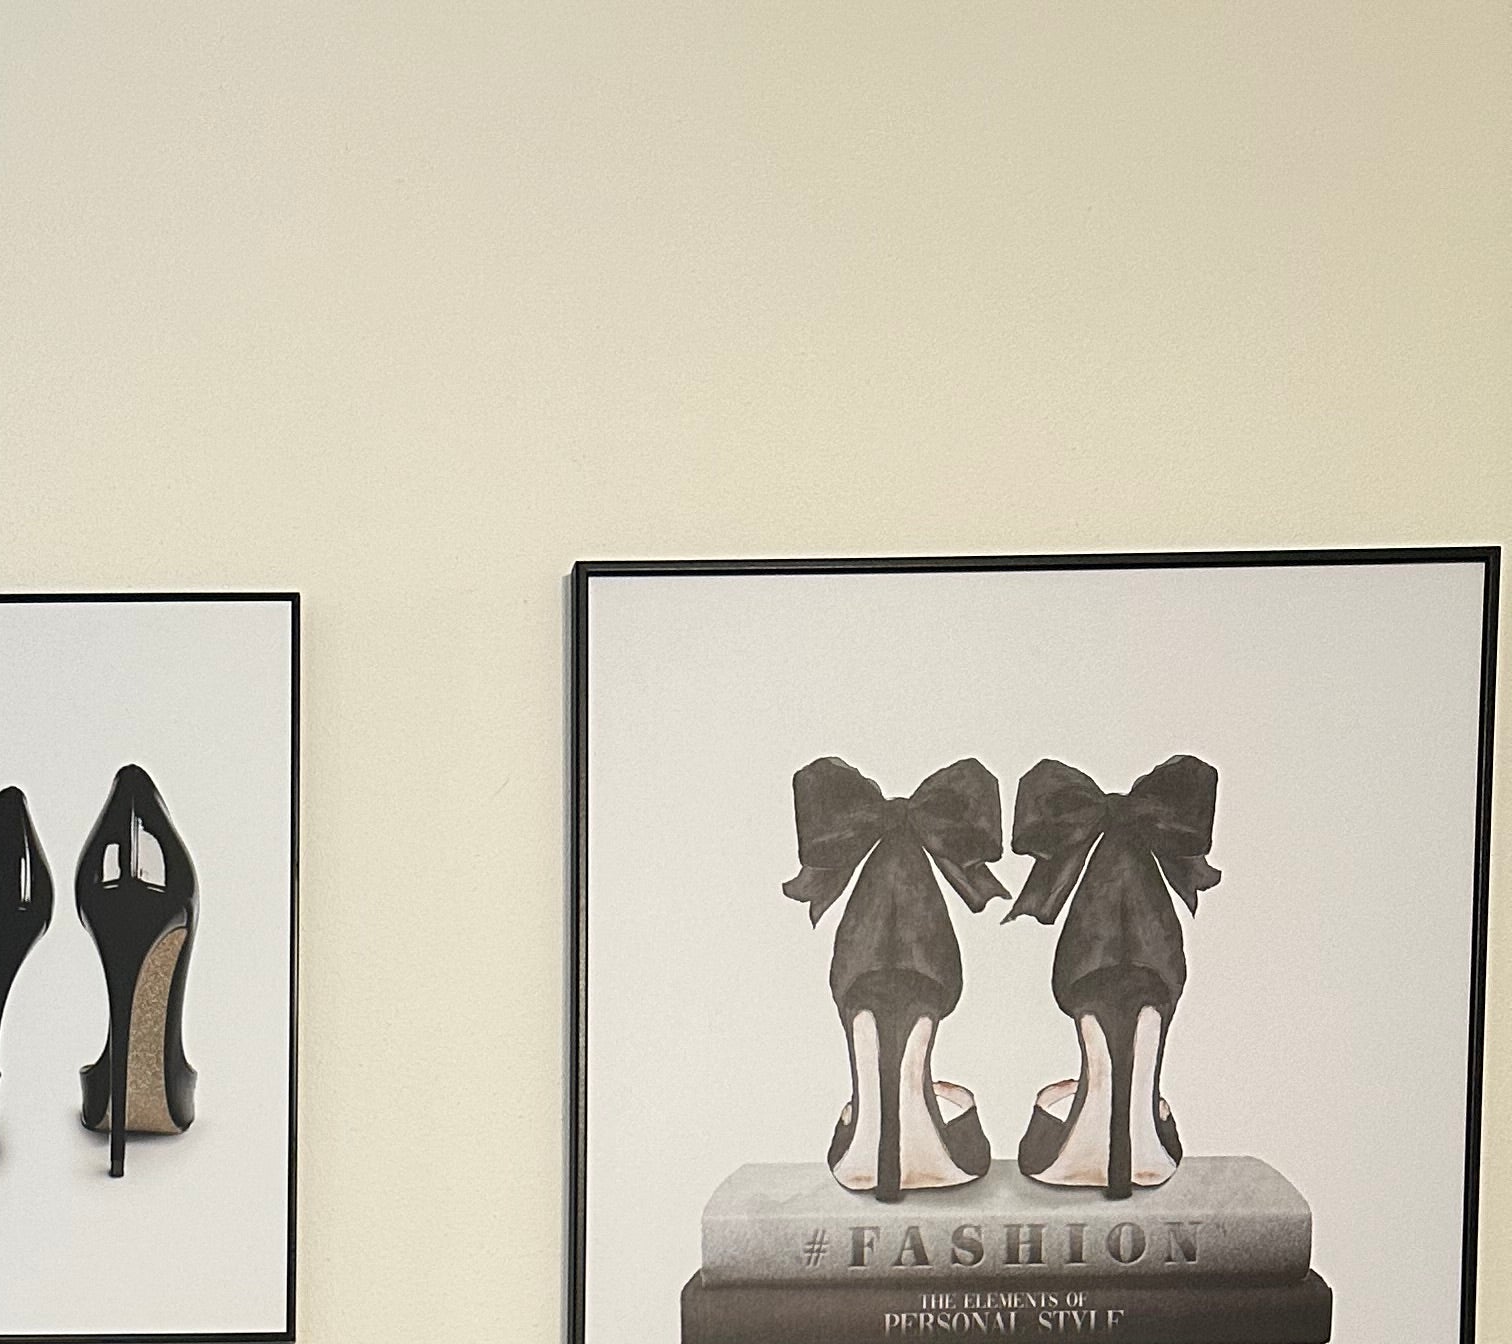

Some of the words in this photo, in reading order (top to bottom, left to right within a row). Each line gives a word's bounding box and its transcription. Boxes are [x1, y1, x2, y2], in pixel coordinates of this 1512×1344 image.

[921, 1293, 955, 1311] THE
[963, 1291, 1059, 1310] ELEMENTS
[1065, 1290, 1089, 1307] OF
[883, 1310, 1023, 1337] PERSONAL
[1037, 1308, 1126, 1334] STYLE
